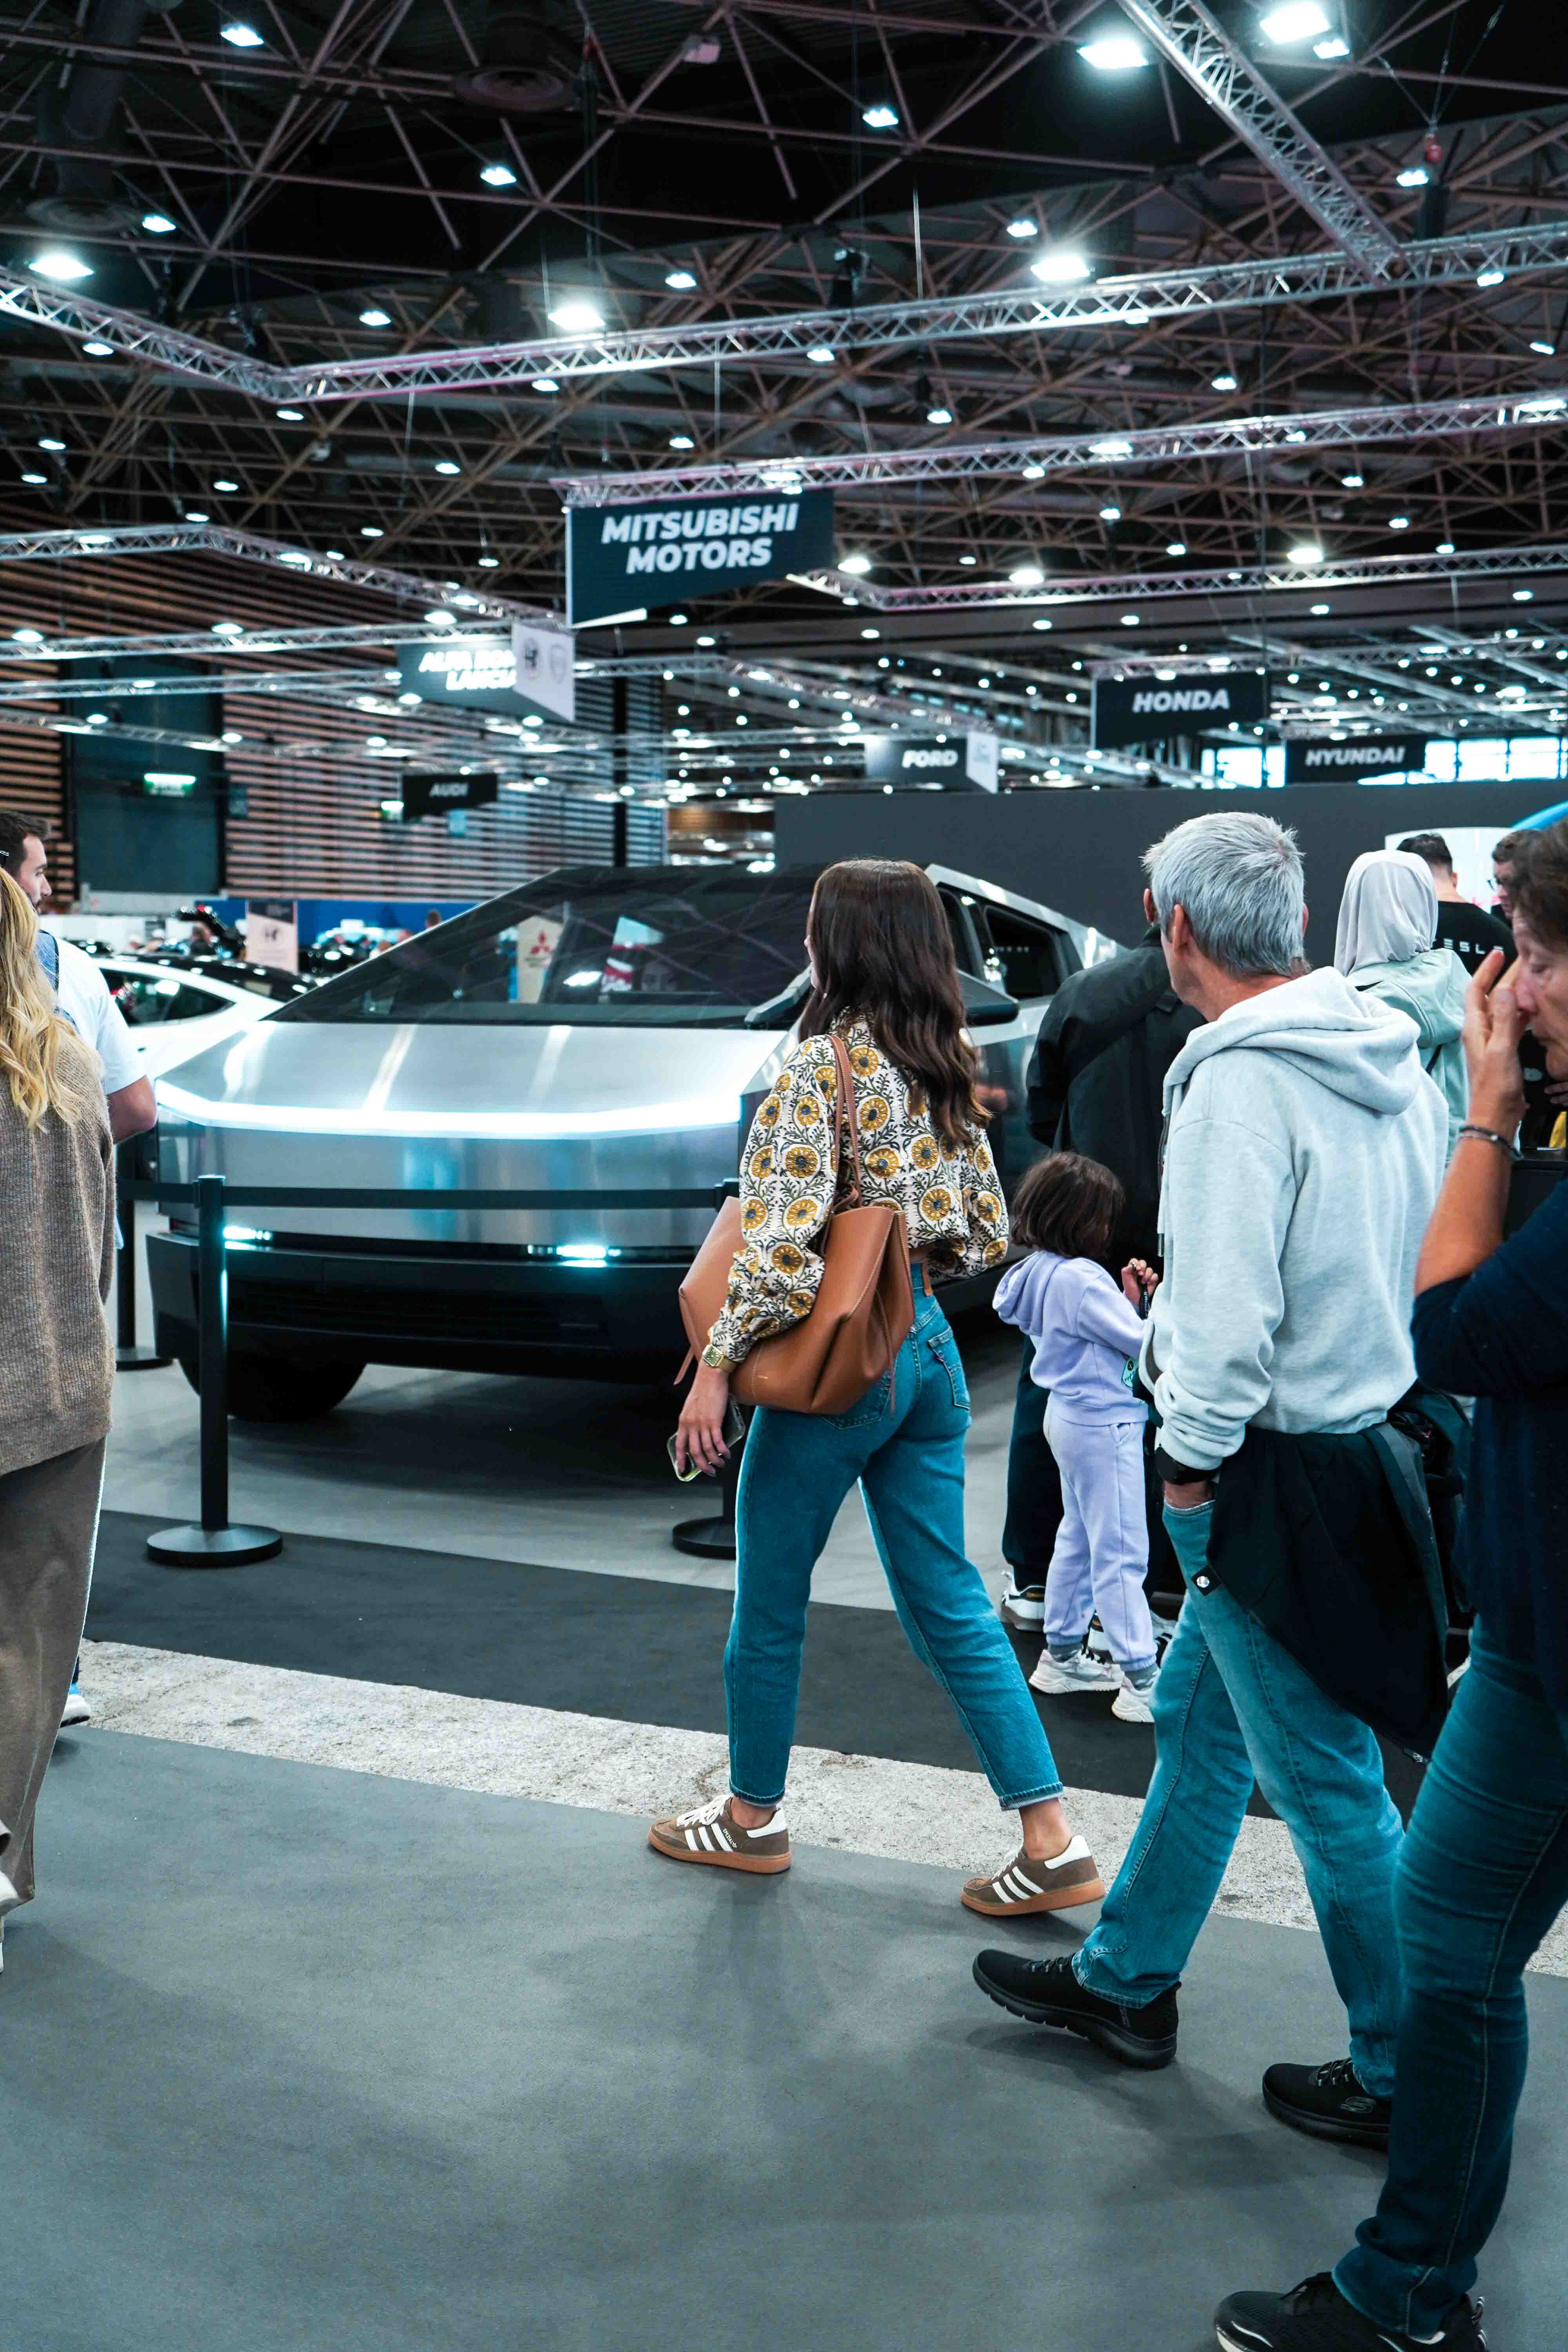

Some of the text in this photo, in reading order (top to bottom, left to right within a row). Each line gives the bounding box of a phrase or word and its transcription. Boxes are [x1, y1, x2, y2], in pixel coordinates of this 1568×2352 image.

[601, 503, 799, 544] MITSUBISHI
[626, 537, 773, 574] MOTORS
[1131, 688, 1230, 713] HONDA
[902, 749, 958, 768] FORD
[1305, 746, 1405, 766] HYUNDAI
[1430, 938, 1504, 955] ESL
[723, 1828, 734, 1844] SPEZIAL
